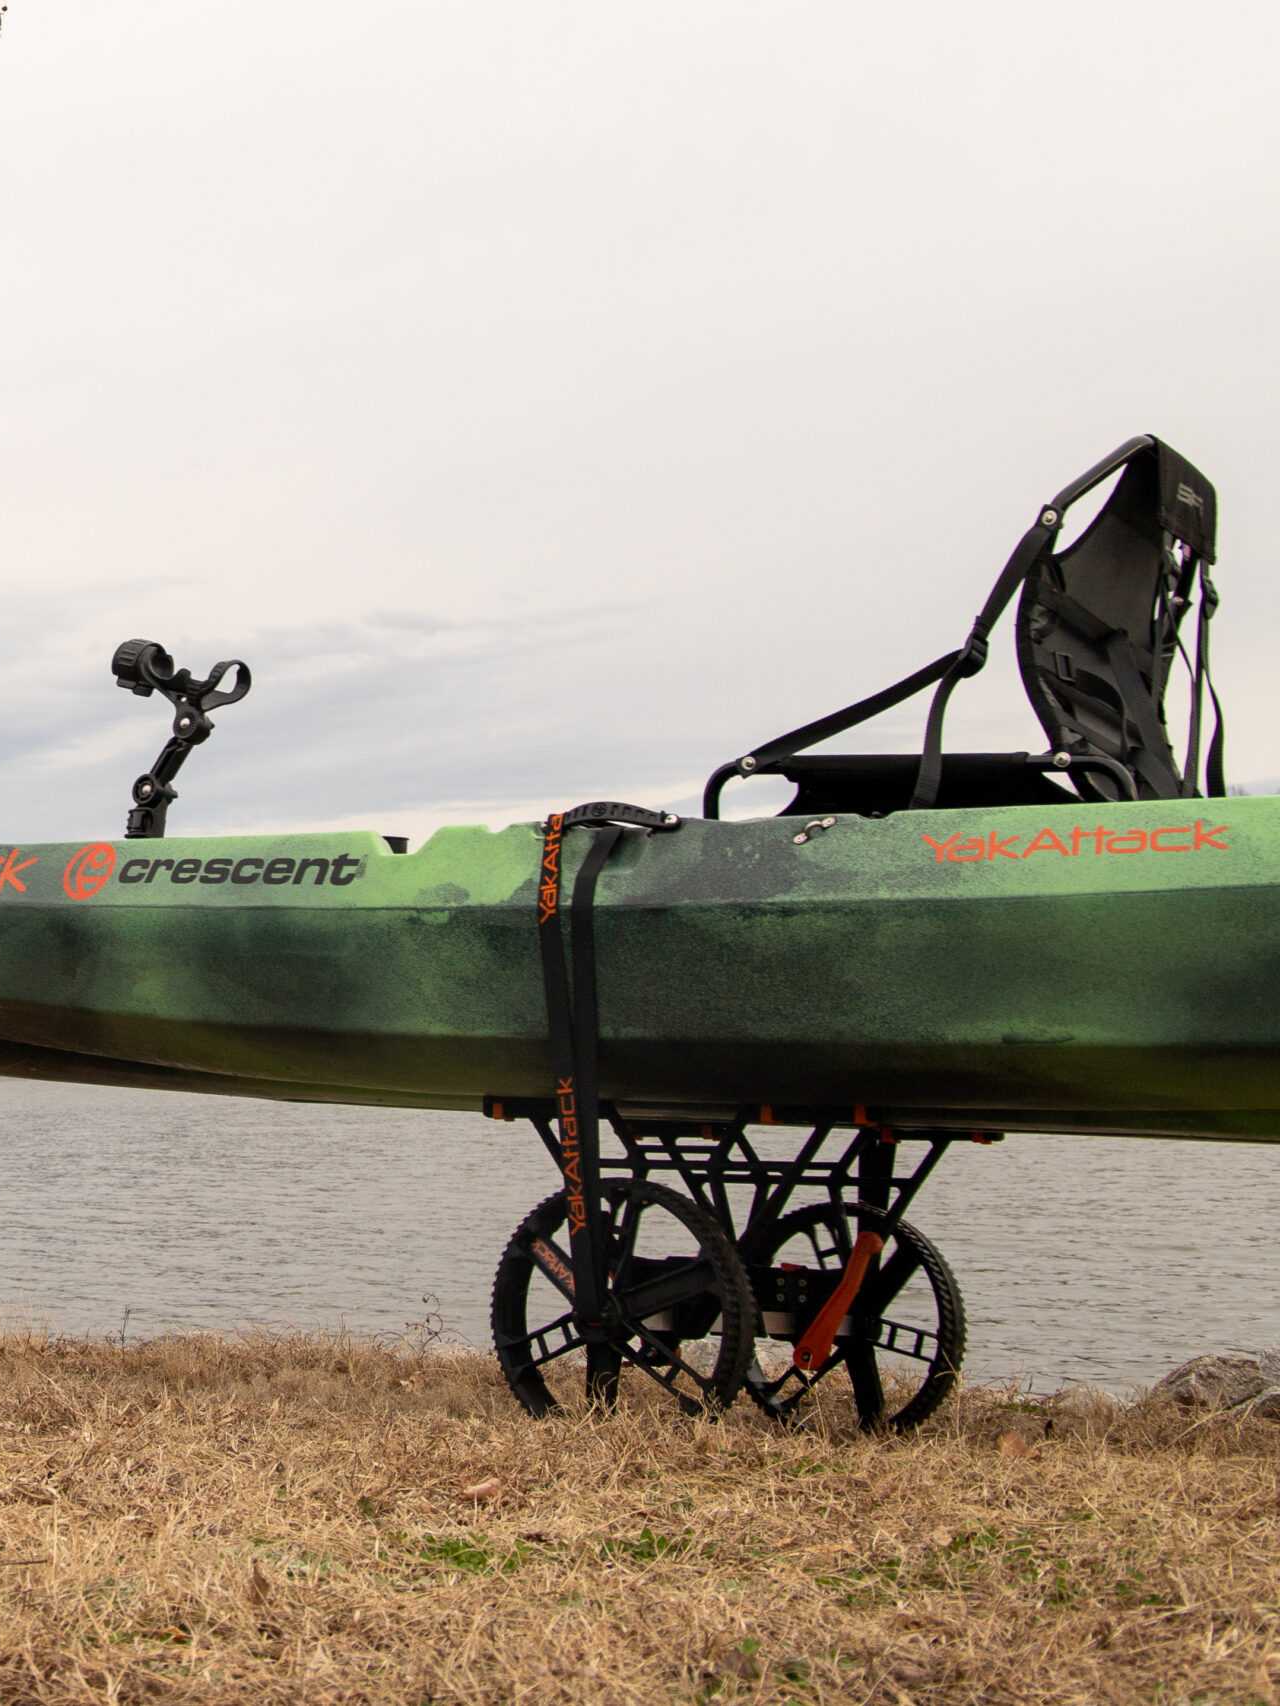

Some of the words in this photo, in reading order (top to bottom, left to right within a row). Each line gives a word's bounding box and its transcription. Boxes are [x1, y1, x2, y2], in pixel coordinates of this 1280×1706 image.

[922, 820, 1229, 863] YakAttack
[119, 853, 360, 885] crescent
[539, 813, 564, 924] YakAtta
[556, 1077, 587, 1236] YakAttack
[531, 1239, 576, 1291] kAttack
